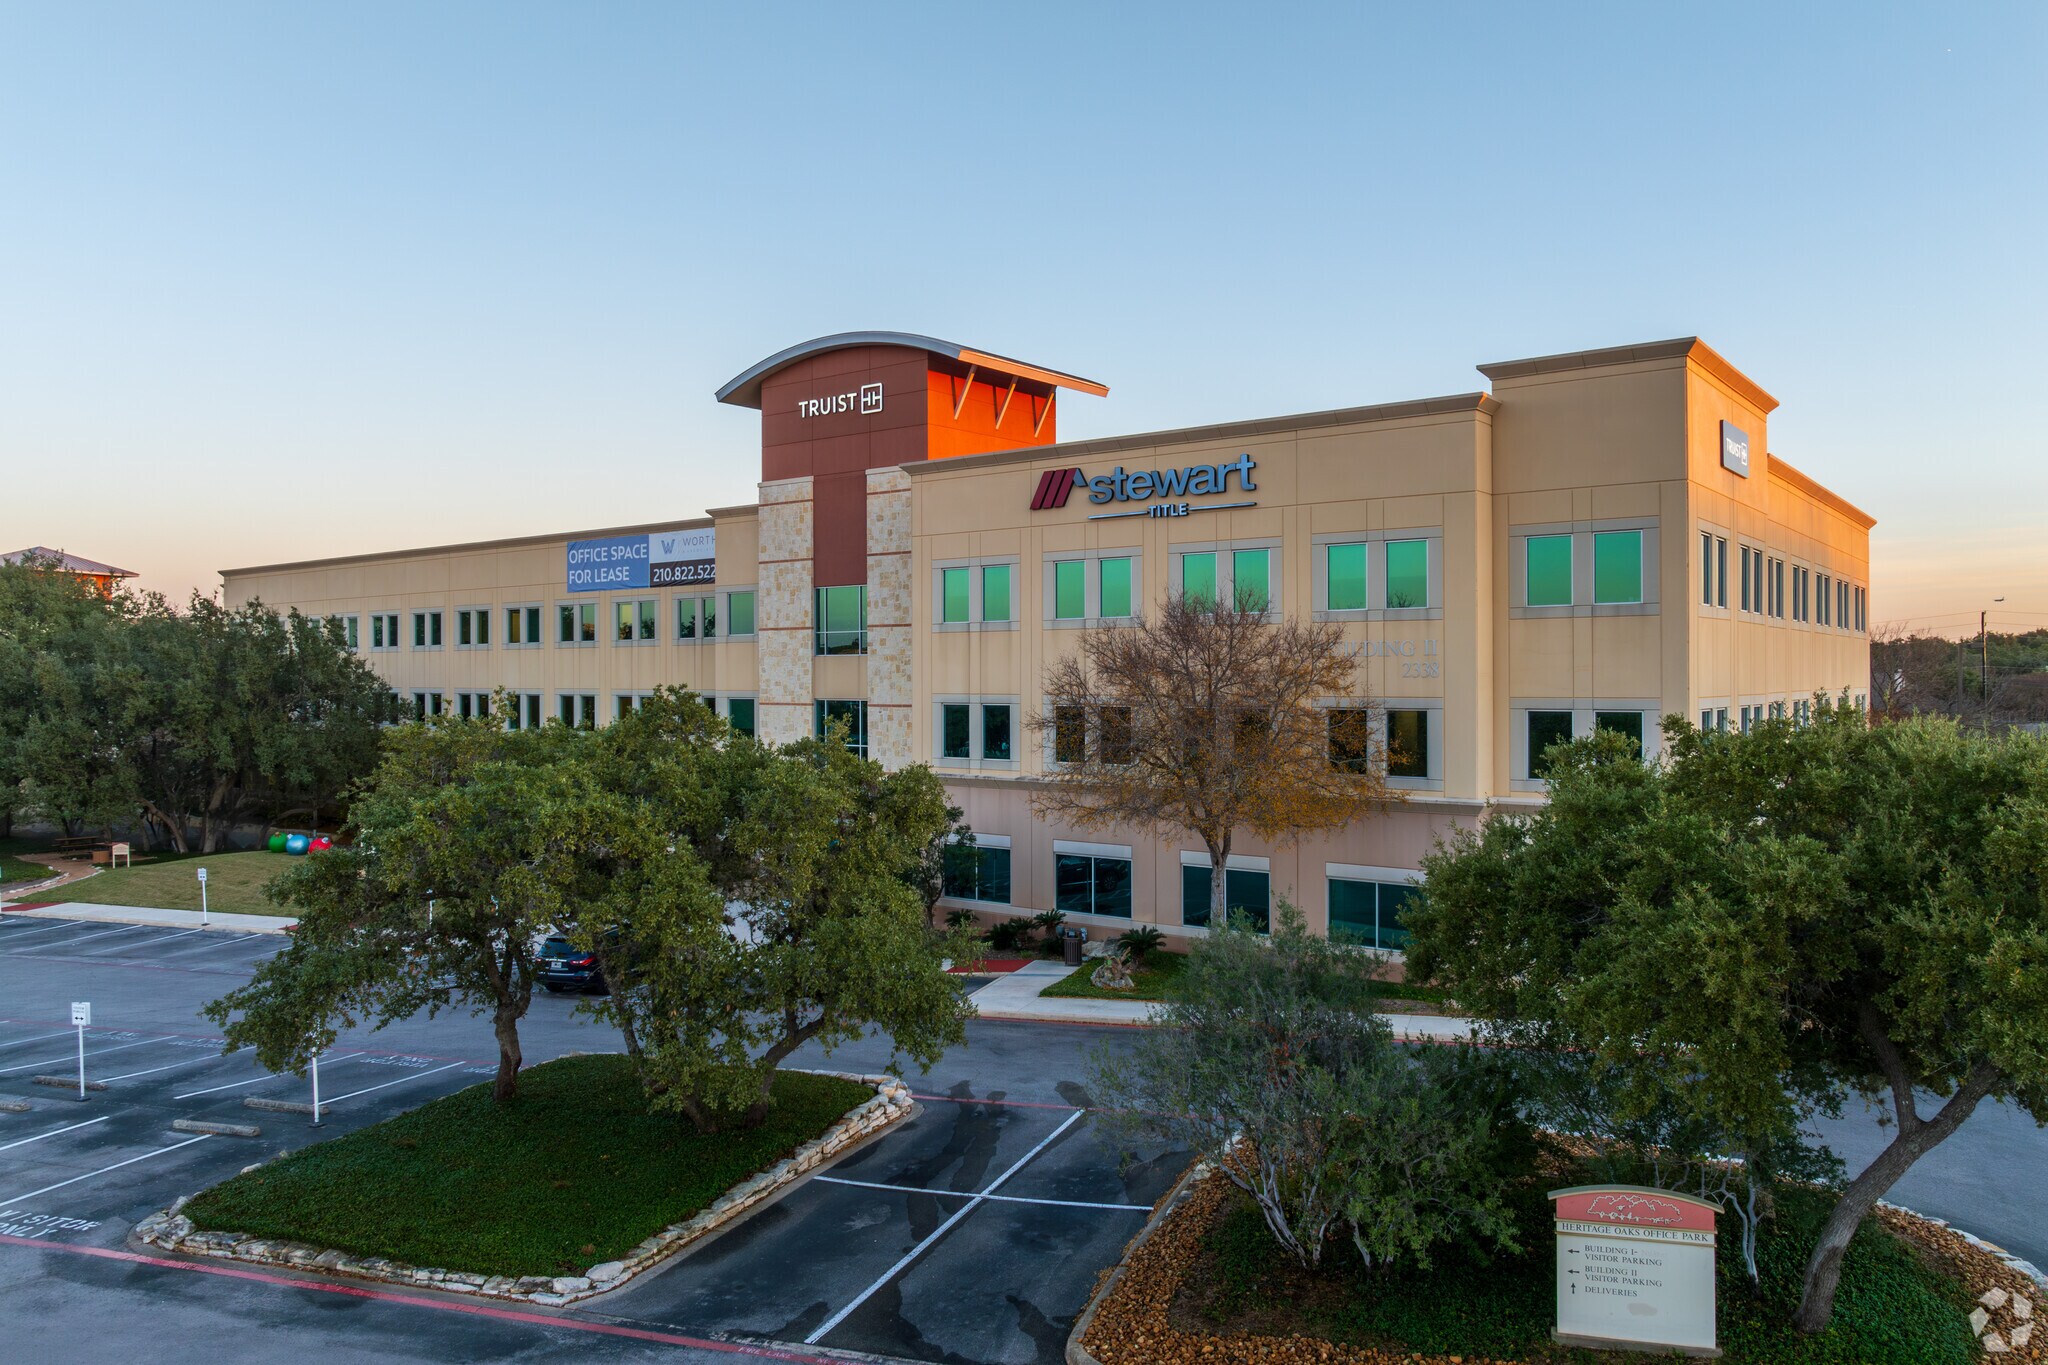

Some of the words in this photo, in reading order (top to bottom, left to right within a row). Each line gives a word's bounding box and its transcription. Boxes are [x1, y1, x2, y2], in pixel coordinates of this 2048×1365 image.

[798, 392, 858, 418] TRUIST
[1088, 453, 1257, 504] stewart
[1148, 502, 1190, 518] TITLE
[568, 547, 608, 564] OFFICE
[611, 543, 648, 562] SPACE
[568, 569, 592, 585] FOR
[594, 566, 630, 583] LEASE
[653, 564, 716, 582] 210.822.522
[1424, 640, 1438, 656] II
[1402, 661, 1440, 679] 2338
[1562, 1222, 1612, 1234] HERITAGE
[1614, 1226, 1640, 1236] OAKS
[1644, 1229, 1678, 1240] OFFICE
[1682, 1232, 1709, 1242] PARK
[1584, 1245, 1628, 1255] BUILDING
[1585, 1253, 1619, 1263] VISITOR
[1622, 1256, 1662, 1266] PARKING
[1584, 1266, 1628, 1276] BUILDING
[1585, 1274, 1619, 1283] VISITOR
[1622, 1277, 1662, 1287] PARKING
[1585, 1286, 1638, 1297] DELIVERIES
